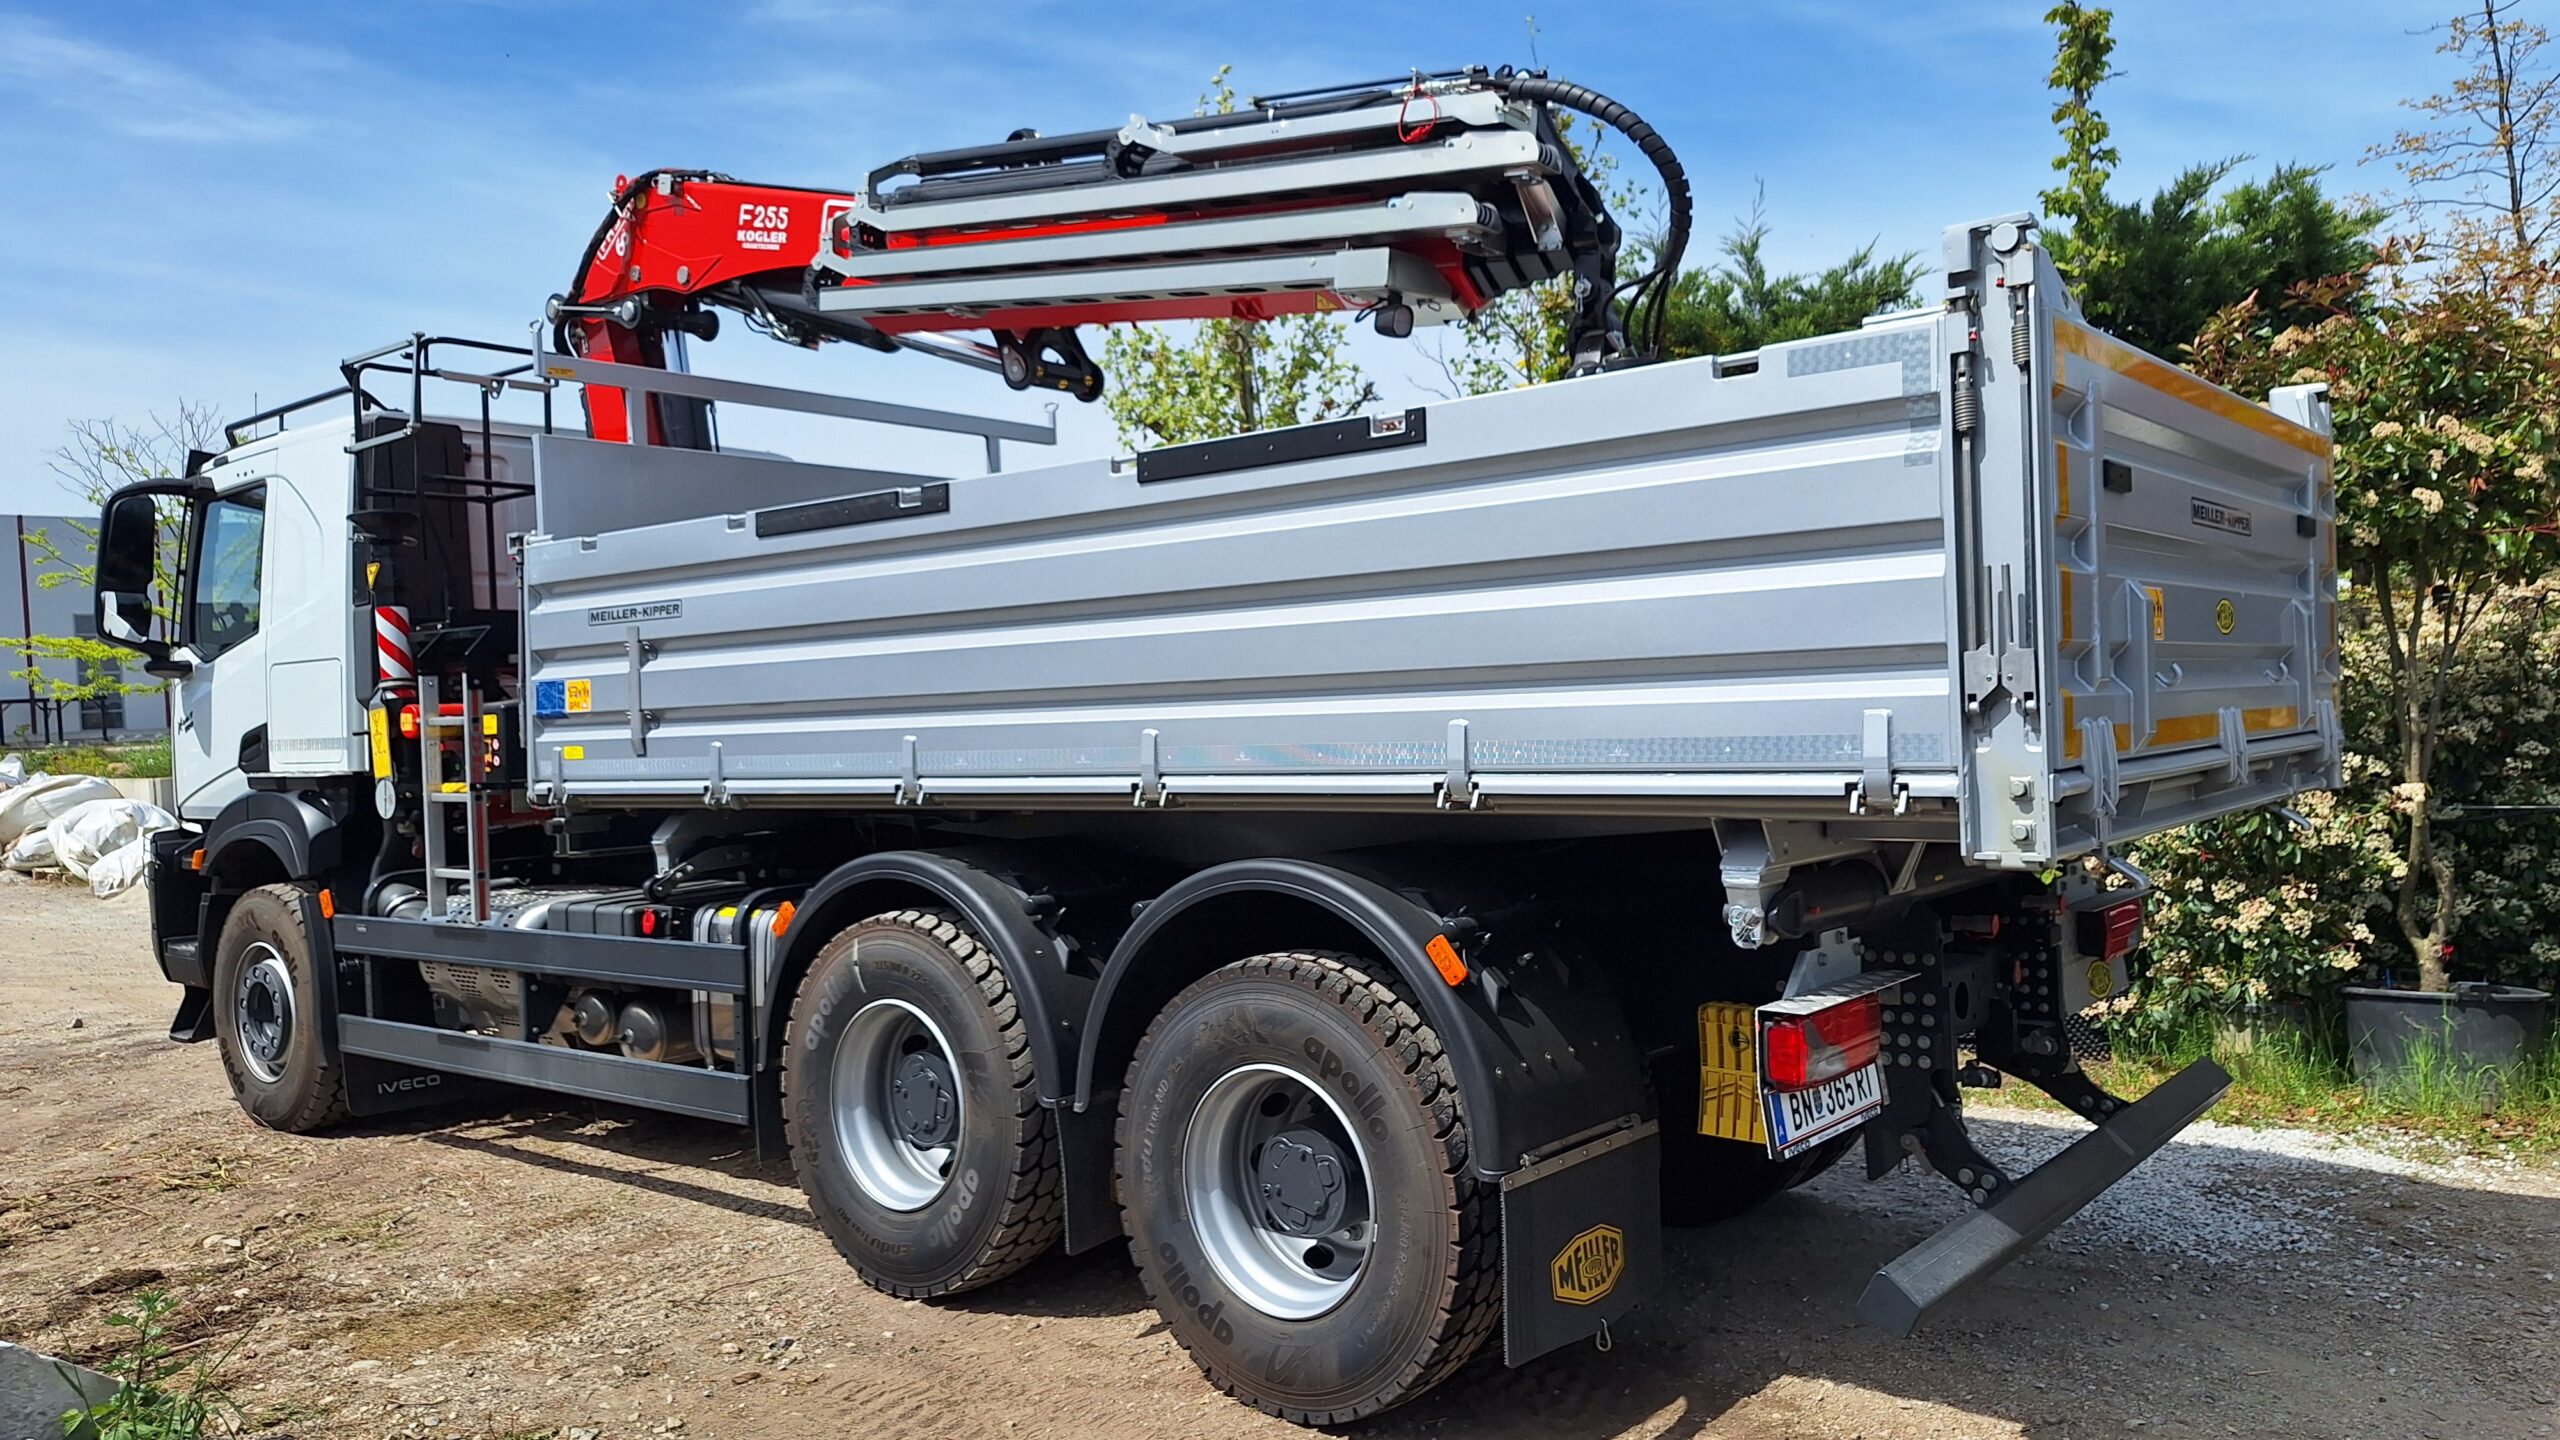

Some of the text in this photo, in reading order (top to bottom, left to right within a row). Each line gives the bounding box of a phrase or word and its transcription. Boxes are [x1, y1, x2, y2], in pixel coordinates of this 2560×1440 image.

[739, 203, 789, 229] F255
[737, 230, 787, 244] KOGLER
[590, 603, 680, 622] MEILLER-KIPPER
[377, 1074, 441, 1094] IVECO
[1303, 1036, 1389, 1142] apollo
[1788, 1090, 1815, 1131] BN
[1823, 1076, 1855, 1116] 365
[1788, 1139, 1811, 1156] IVECO
[1558, 1234, 1620, 1293] MEILLER
[1160, 1241, 1234, 1346] apollo
